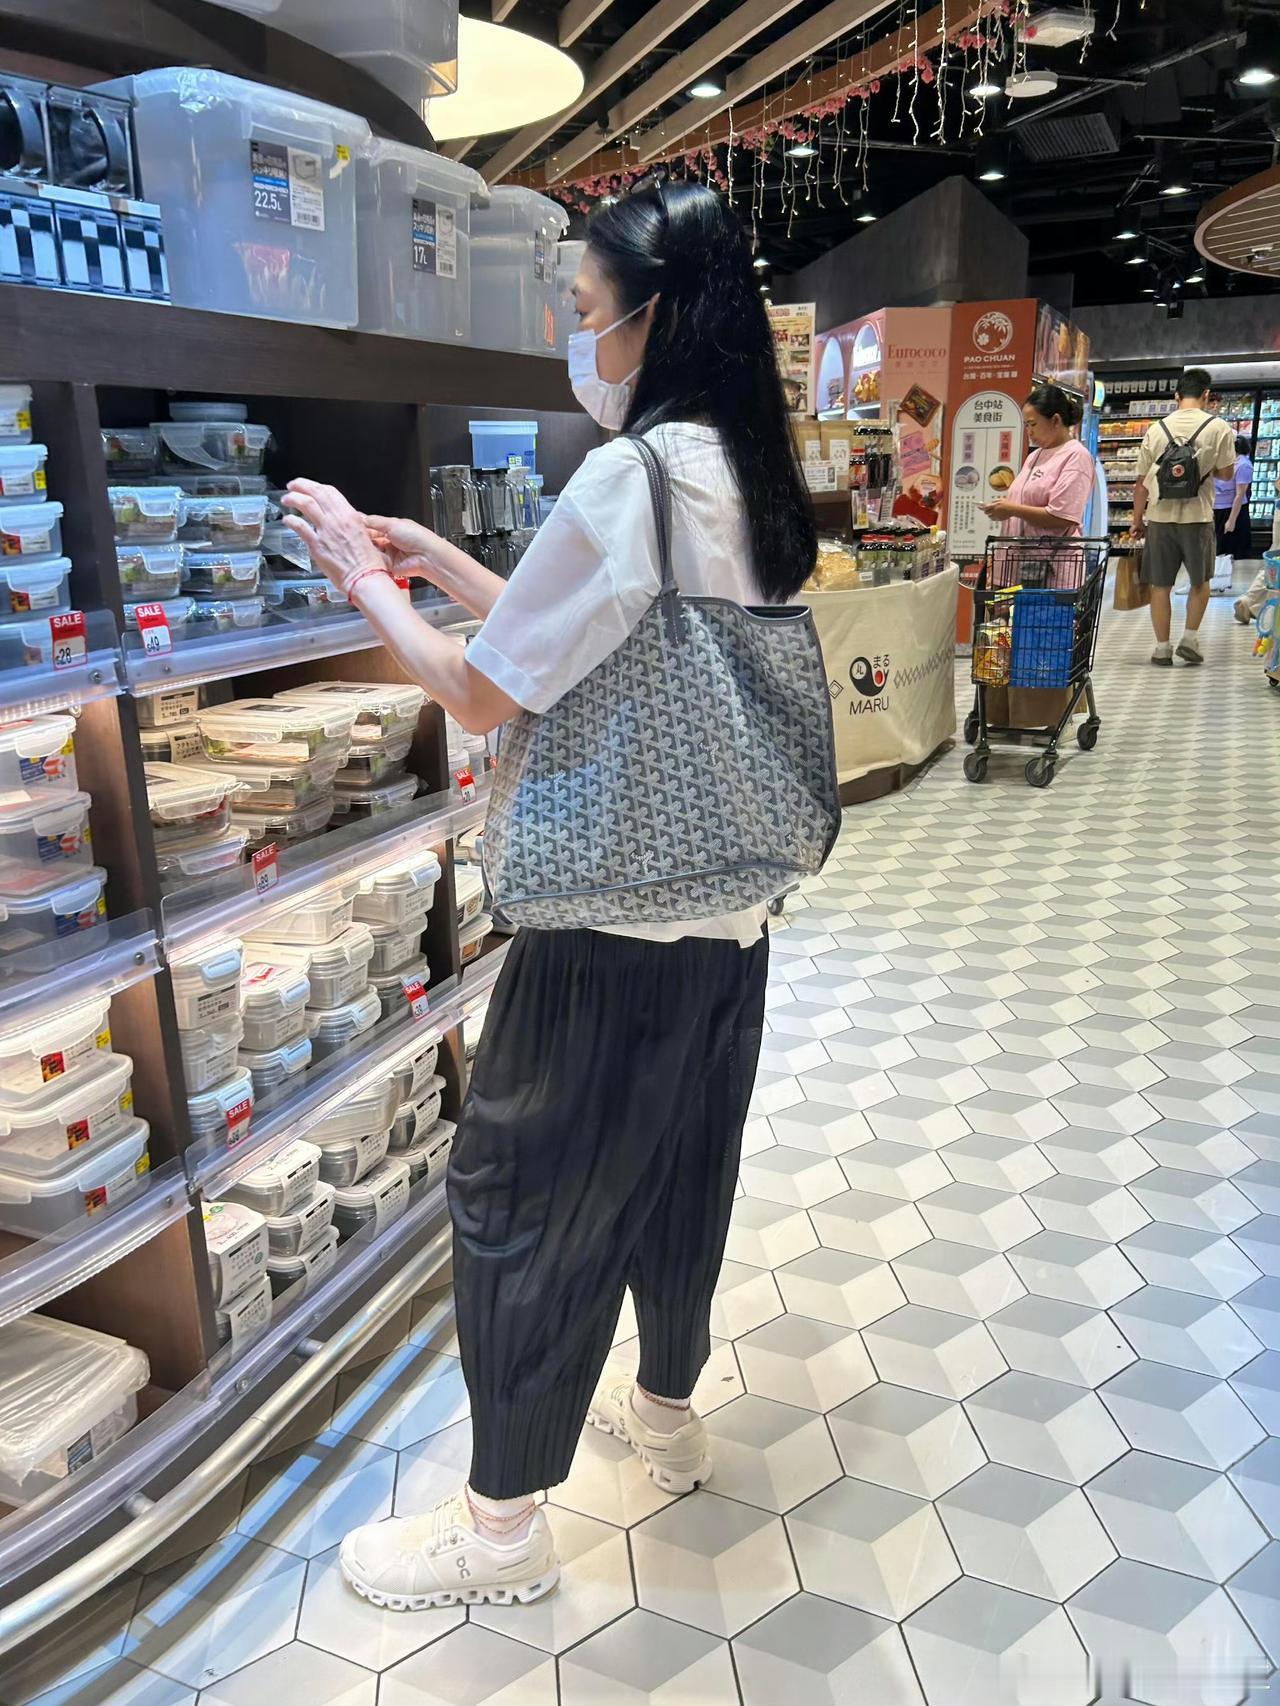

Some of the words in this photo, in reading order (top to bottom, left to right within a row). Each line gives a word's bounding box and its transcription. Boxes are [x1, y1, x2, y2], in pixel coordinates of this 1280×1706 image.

[254, 190, 283, 211] 22.5L
[413, 245, 428, 264] 17L
[887, 344, 946, 359] Eurococo
[983, 354, 1016, 362] CHUAN
[974, 400, 1003, 410] 台中站
[973, 411, 1003, 422] 美食街
[137, 605, 162, 617] SALE
[53, 613, 83, 628] SALE
[873, 655, 890, 669] まる
[849, 696, 890, 715] MARU
[255, 846, 275, 862] SALE
[404, 981, 421, 994] SALE
[228, 1101, 249, 1118] SALE
